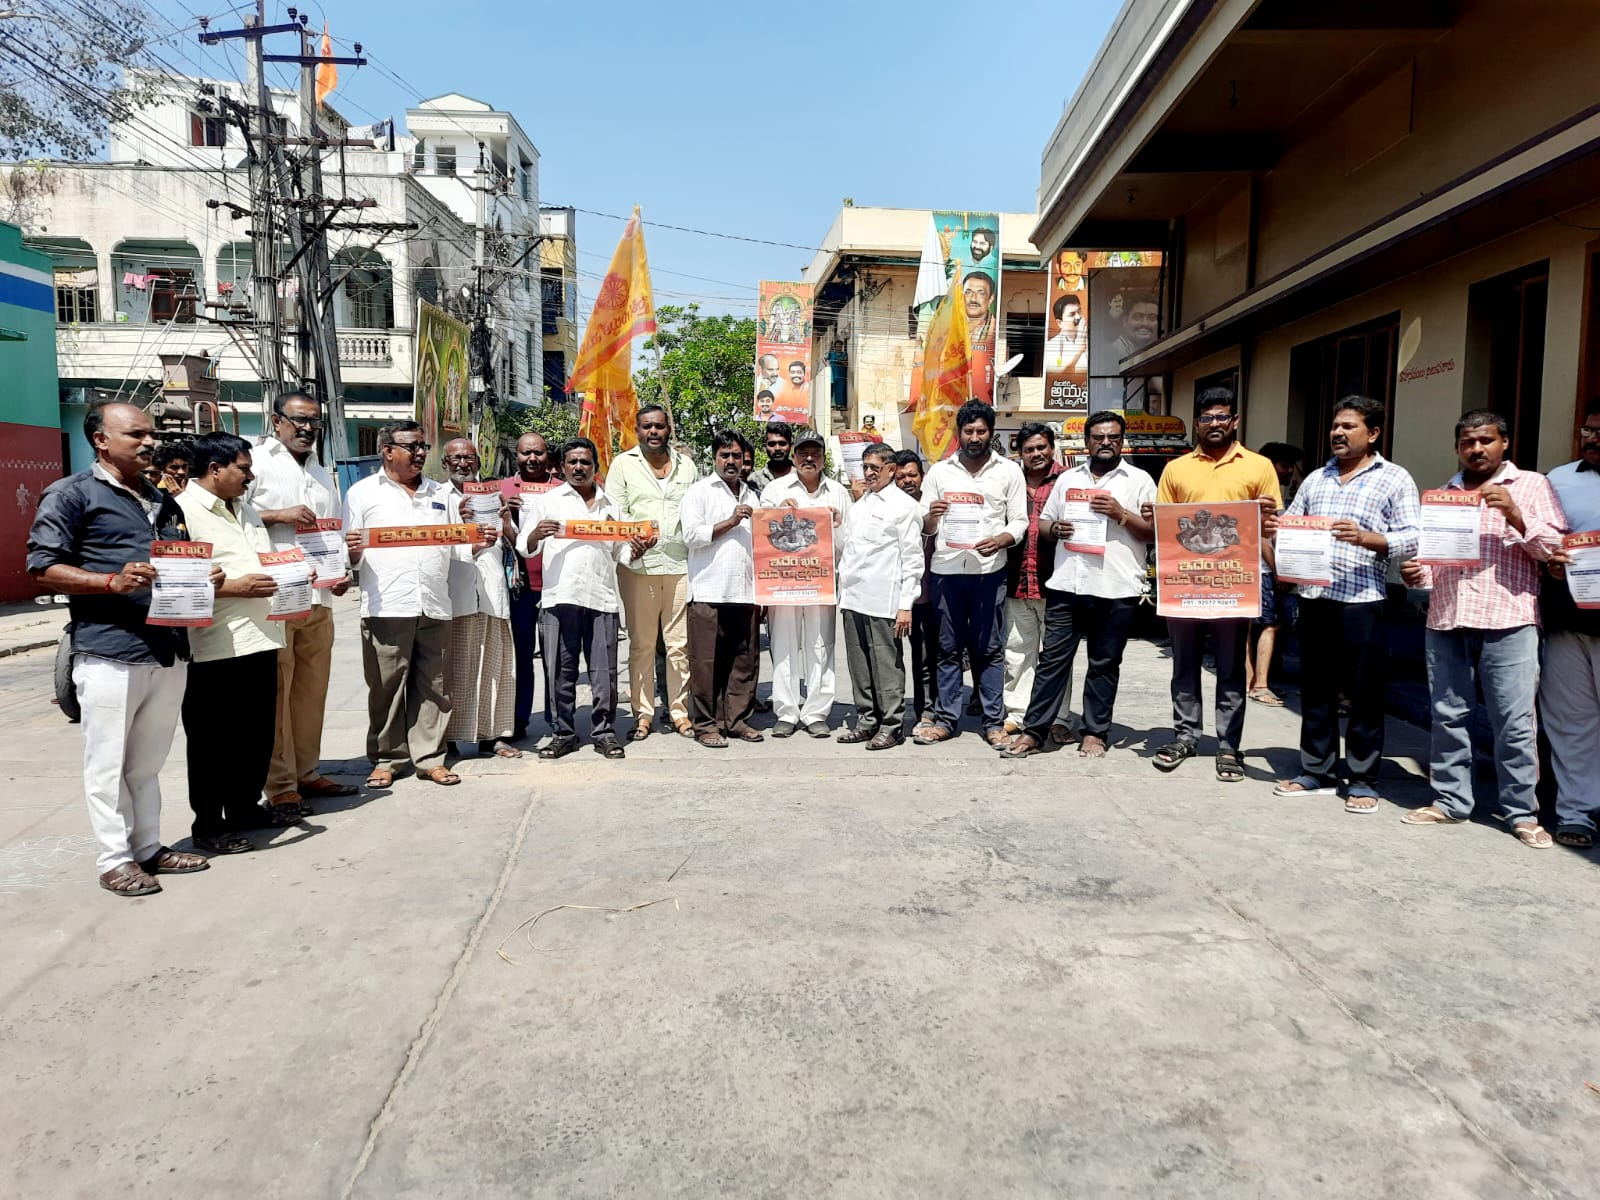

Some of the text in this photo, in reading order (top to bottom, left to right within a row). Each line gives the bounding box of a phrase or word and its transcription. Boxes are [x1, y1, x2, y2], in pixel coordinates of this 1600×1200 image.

[377, 526, 431, 543] ఇదేం
[573, 521, 618, 536] ఇదేం
[769, 556, 798, 568] ఇదేం
[1178, 557, 1215, 572] ఇదేం
